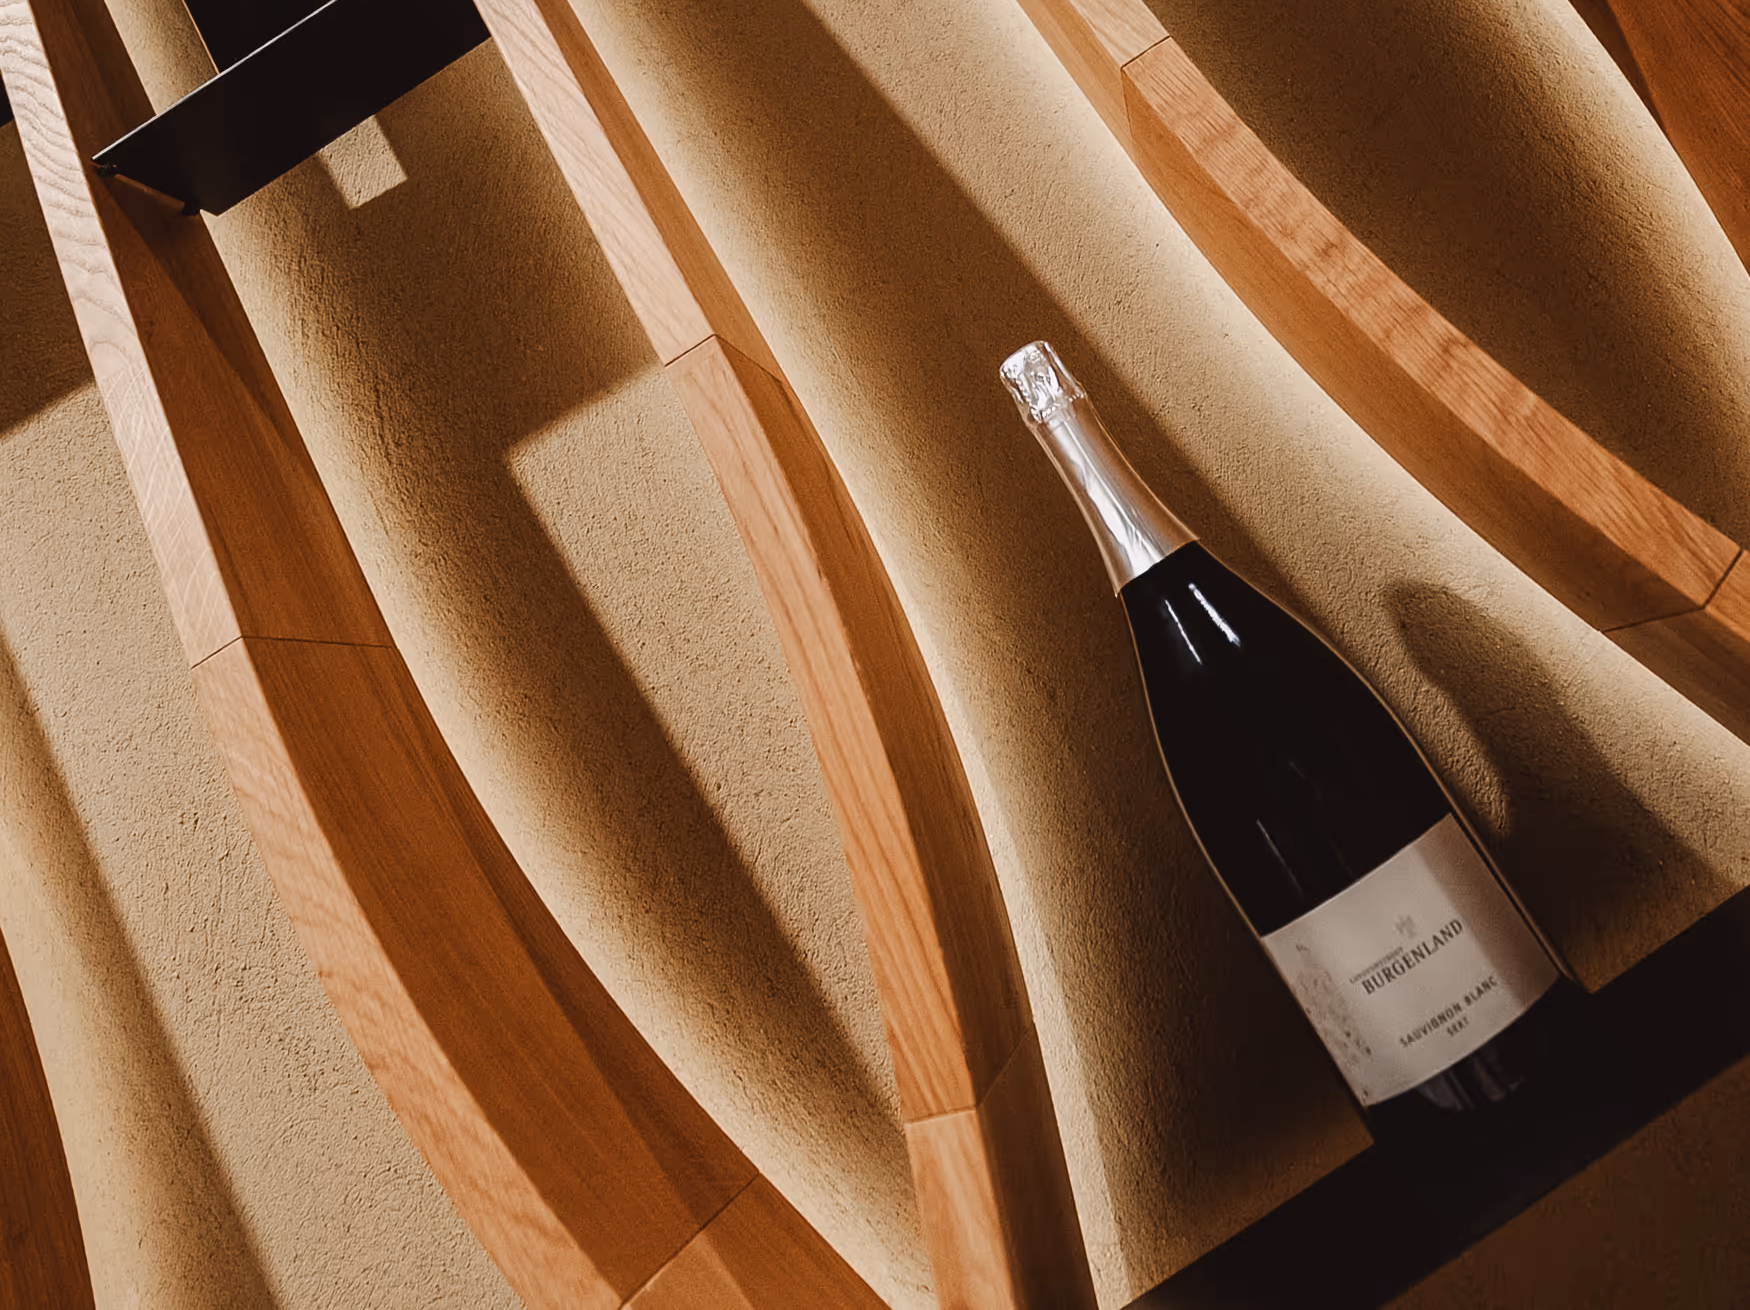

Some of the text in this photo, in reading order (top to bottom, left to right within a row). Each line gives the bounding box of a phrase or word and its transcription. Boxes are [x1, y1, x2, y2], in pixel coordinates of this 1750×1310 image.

[1361, 918, 1464, 995] BURGENLAND
[1399, 975, 1499, 1048] SAUVIGNON BLANC
